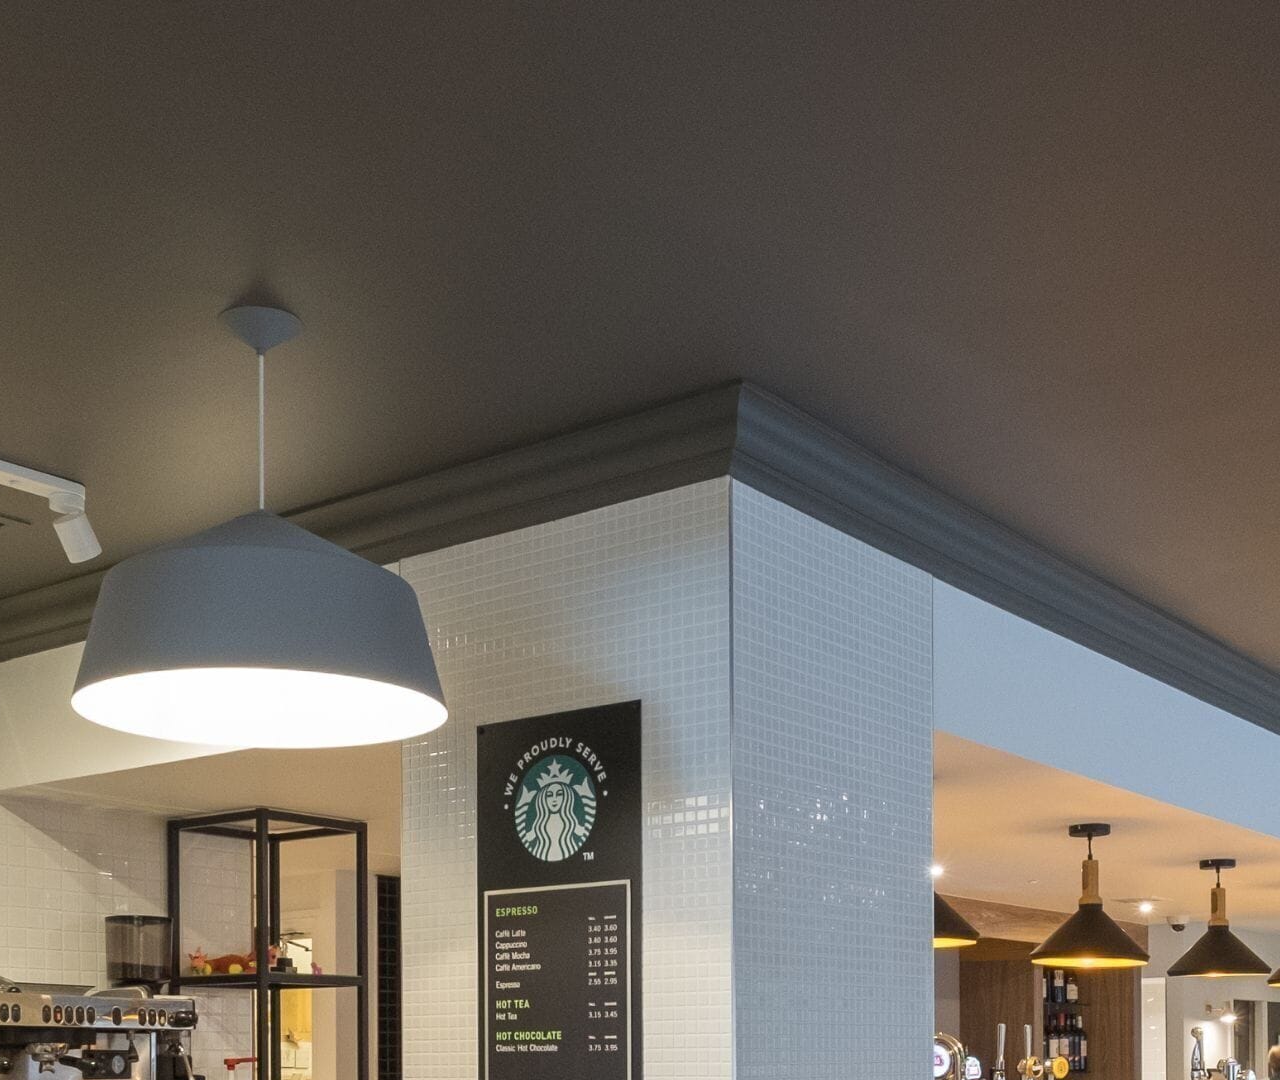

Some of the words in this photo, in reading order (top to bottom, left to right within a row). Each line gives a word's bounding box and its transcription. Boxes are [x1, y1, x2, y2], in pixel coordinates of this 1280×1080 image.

[504, 773, 518, 796] WE
[517, 737, 572, 770] PROUDLY
[575, 742, 607, 783] SERVE
[583, 852, 595, 861] TM
[495, 905, 538, 917] ESPRESSO
[495, 941, 528, 950] Cappuccino
[511, 952, 531, 960] Mocha
[511, 963, 541, 971] Americano
[495, 981, 521, 990] Espresso
[496, 1000, 512, 1009] HOT
[514, 1000, 530, 1009] TEA
[496, 1012, 506, 1020] Hot
[496, 1032, 512, 1041] HOT
[514, 1031, 562, 1040] CHOCOLATE
[496, 1044, 516, 1052] Classic
[517, 1044, 528, 1052] Hot
[529, 1044, 558, 1052] Chocolate
